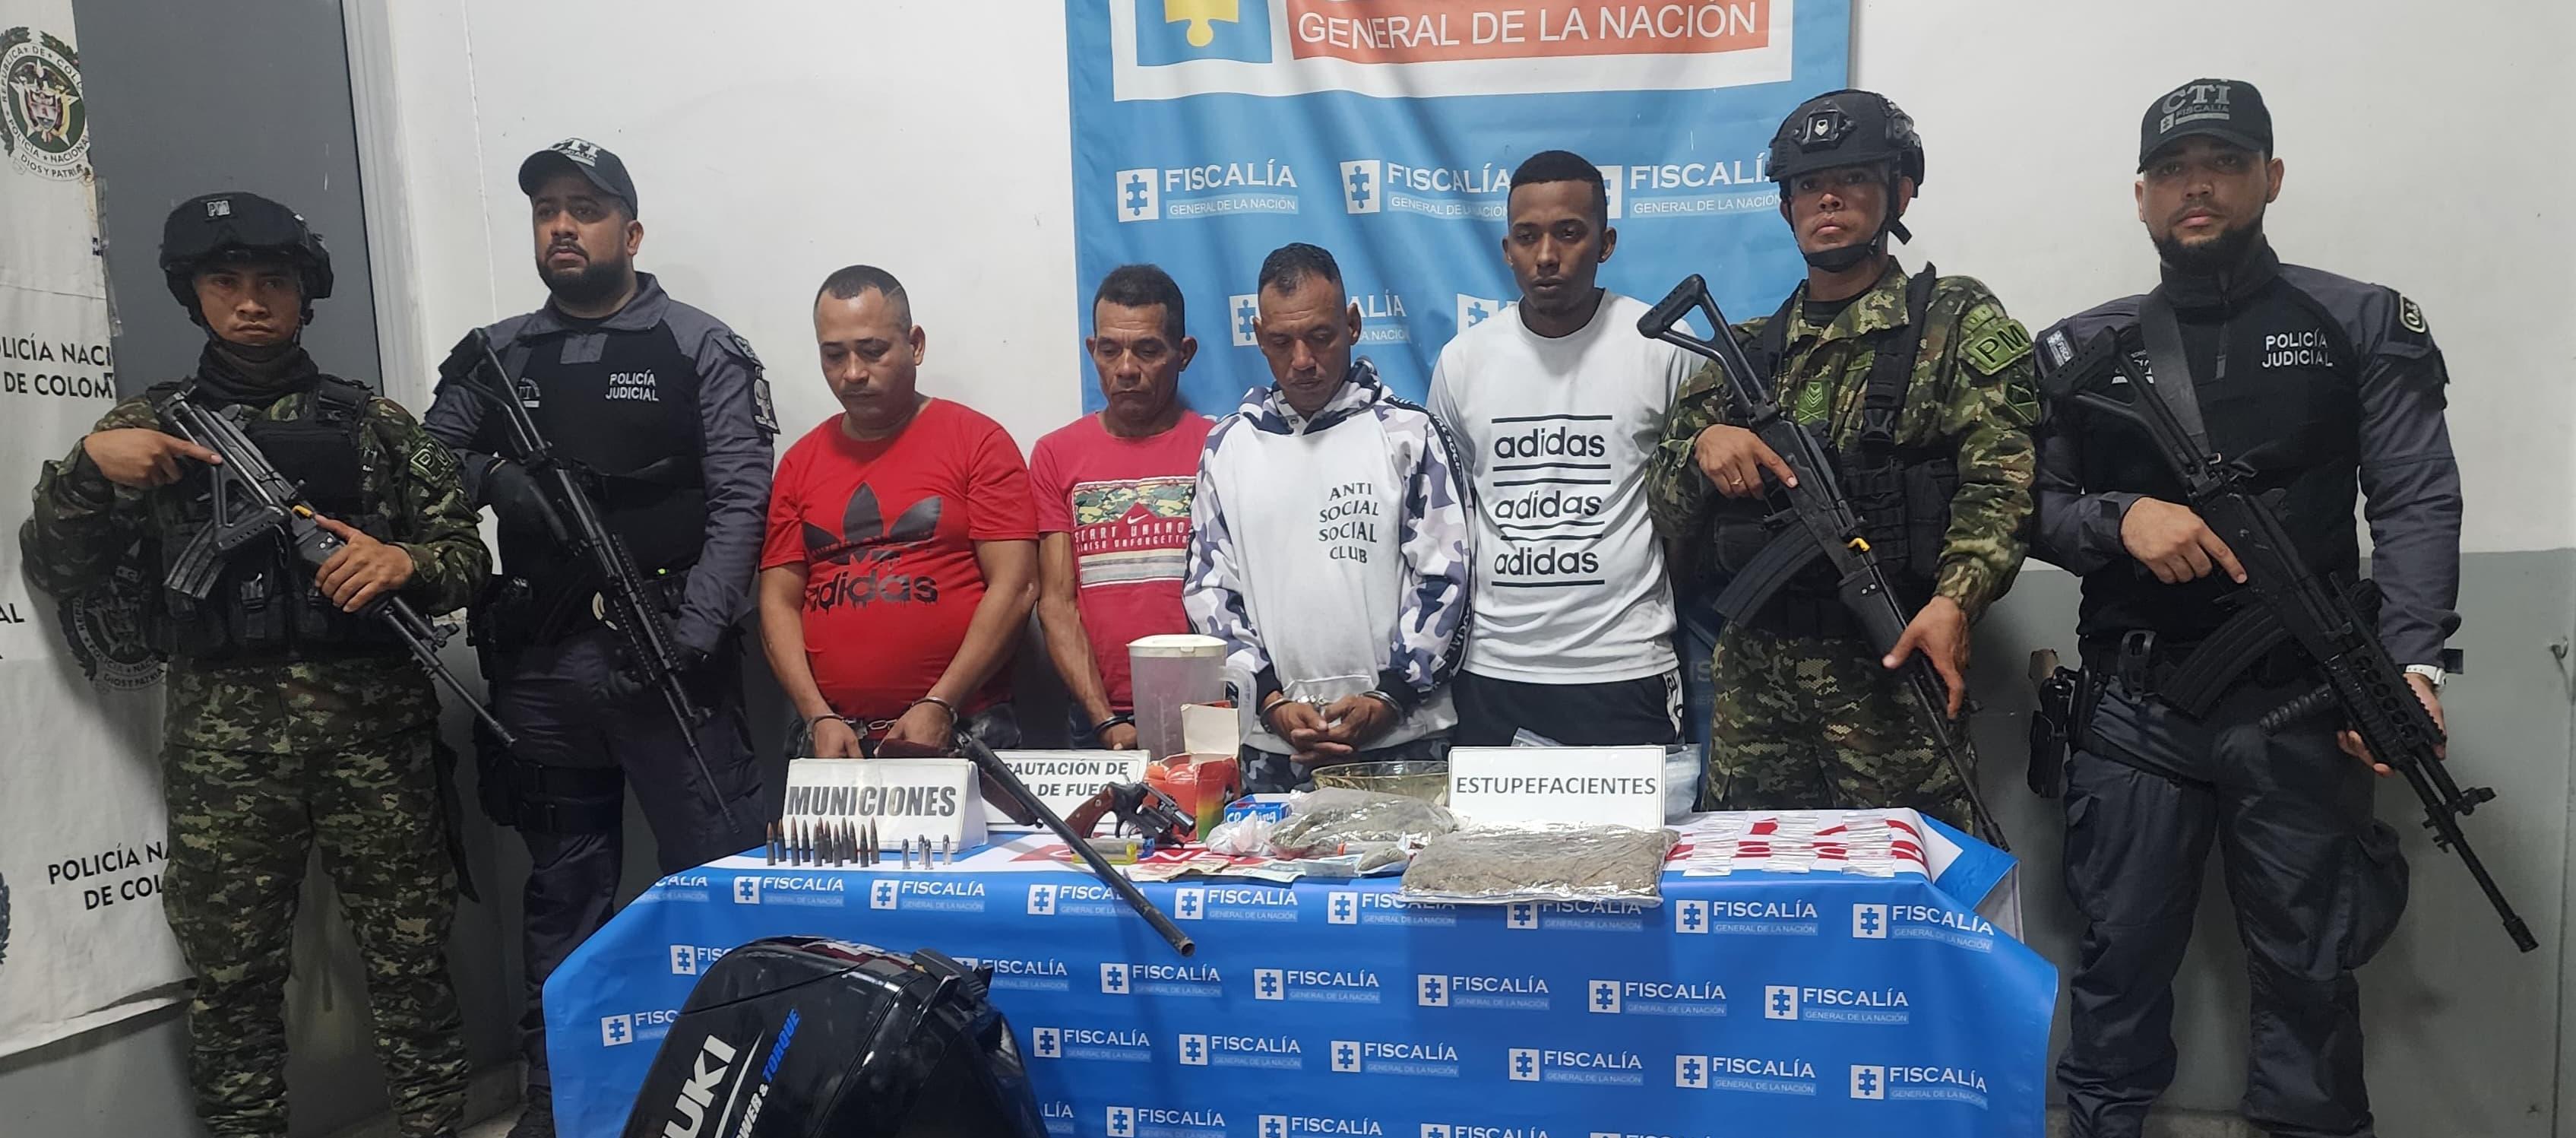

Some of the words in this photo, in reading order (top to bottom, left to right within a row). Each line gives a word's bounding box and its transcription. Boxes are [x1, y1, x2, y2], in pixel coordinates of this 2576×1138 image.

[1298, 12, 1460, 49] GENERAL
[1472, 10, 1525, 45] DE
[1539, 7, 1590, 42] LA
[2162, 84, 2231, 114] CTI
[1165, 159, 1298, 192] FISCALÍA
[1387, 163, 1511, 193] FISCALÍA
[1630, 152, 1770, 189] FISCALÍ
[1169, 201, 1216, 215] GENERAL
[1217, 199, 1231, 211] DE
[1233, 198, 1248, 209] LA
[1250, 196, 1296, 210] NACIÓN
[1391, 196, 1444, 215] GENERAL
[1446, 204, 1462, 215] DE
[1634, 201, 1694, 214] GENERAL
[1697, 200, 1714, 211] DE
[1718, 199, 1733, 210] LA
[0, 332, 55, 363] LICÍA
[1976, 324, 2030, 364] PM
[2265, 328, 2328, 351] POLICÍA
[2261, 347, 2334, 368] JUDICIAL
[4, 371, 28, 394] DE
[609, 369, 657, 386] POLICÍA
[605, 386, 660, 401] JUDICIAL
[1494, 426, 1606, 459] adidas
[1329, 482, 1372, 501] ANTI
[1319, 499, 1379, 523] SOCIAL
[1495, 490, 1603, 520] adidas
[1318, 521, 1378, 543] SOCIAL
[1329, 545, 1368, 564] CLUB
[1494, 546, 1600, 575] adidas
[804, 570, 939, 613] adidas
[1105, 762, 1129, 775] DE
[1037, 783, 1061, 797] DE
[1456, 776, 1657, 795] ESTUPEFACIENTES
[786, 785, 957, 817] MUNICIONES
[48, 842, 141, 885] POLICÍA
[763, 876, 844, 892] FISCALÍA
[901, 880, 986, 896] FISCALÍA
[84, 885, 113, 910] DE
[1207, 887, 1299, 906] FISCALÍA
[1714, 899, 1818, 918] FISCALÍA
[1716, 924, 1755, 933] GENERAL
[1771, 925, 1782, 934] LA
[1783, 924, 1816, 934] NACIÓN
[1892, 905, 1995, 936] FISCALÍA
[1894, 928, 1934, 937] GENERAL
[1957, 937, 1991, 950] NACIÓN
[1132, 964, 1221, 982] FISCALÍA
[1287, 970, 1379, 987] FISCALÍA
[1453, 975, 1549, 994] FISCALÍA
[1625, 981, 1726, 1000] FISCALÍA
[1803, 988, 1909, 1007] FISCALÍA
[1805, 1011, 1846, 1020] GENERAL
[1847, 1013, 1859, 1021] DE
[1874, 1012, 1907, 1022] NACIÓN
[762, 1009, 801, 1083] TORQUE
[1064, 1029, 1150, 1047] FISCALÍA
[1211, 1035, 1301, 1054] FISCALÍA
[1365, 1042, 1458, 1061] FISCALÍA
[1544, 1051, 1643, 1070] FISCALÍA
[1713, 1058, 1815, 1079] FISCALÍA
[661, 1035, 737, 1138] UKI
[1889, 1066, 1987, 1093] FISCALÍA
[759, 1083, 769, 1098] &
[1139, 1109, 1226, 1127] FISCALÍA
[1292, 1118, 1382, 1136] FISCALÍA
